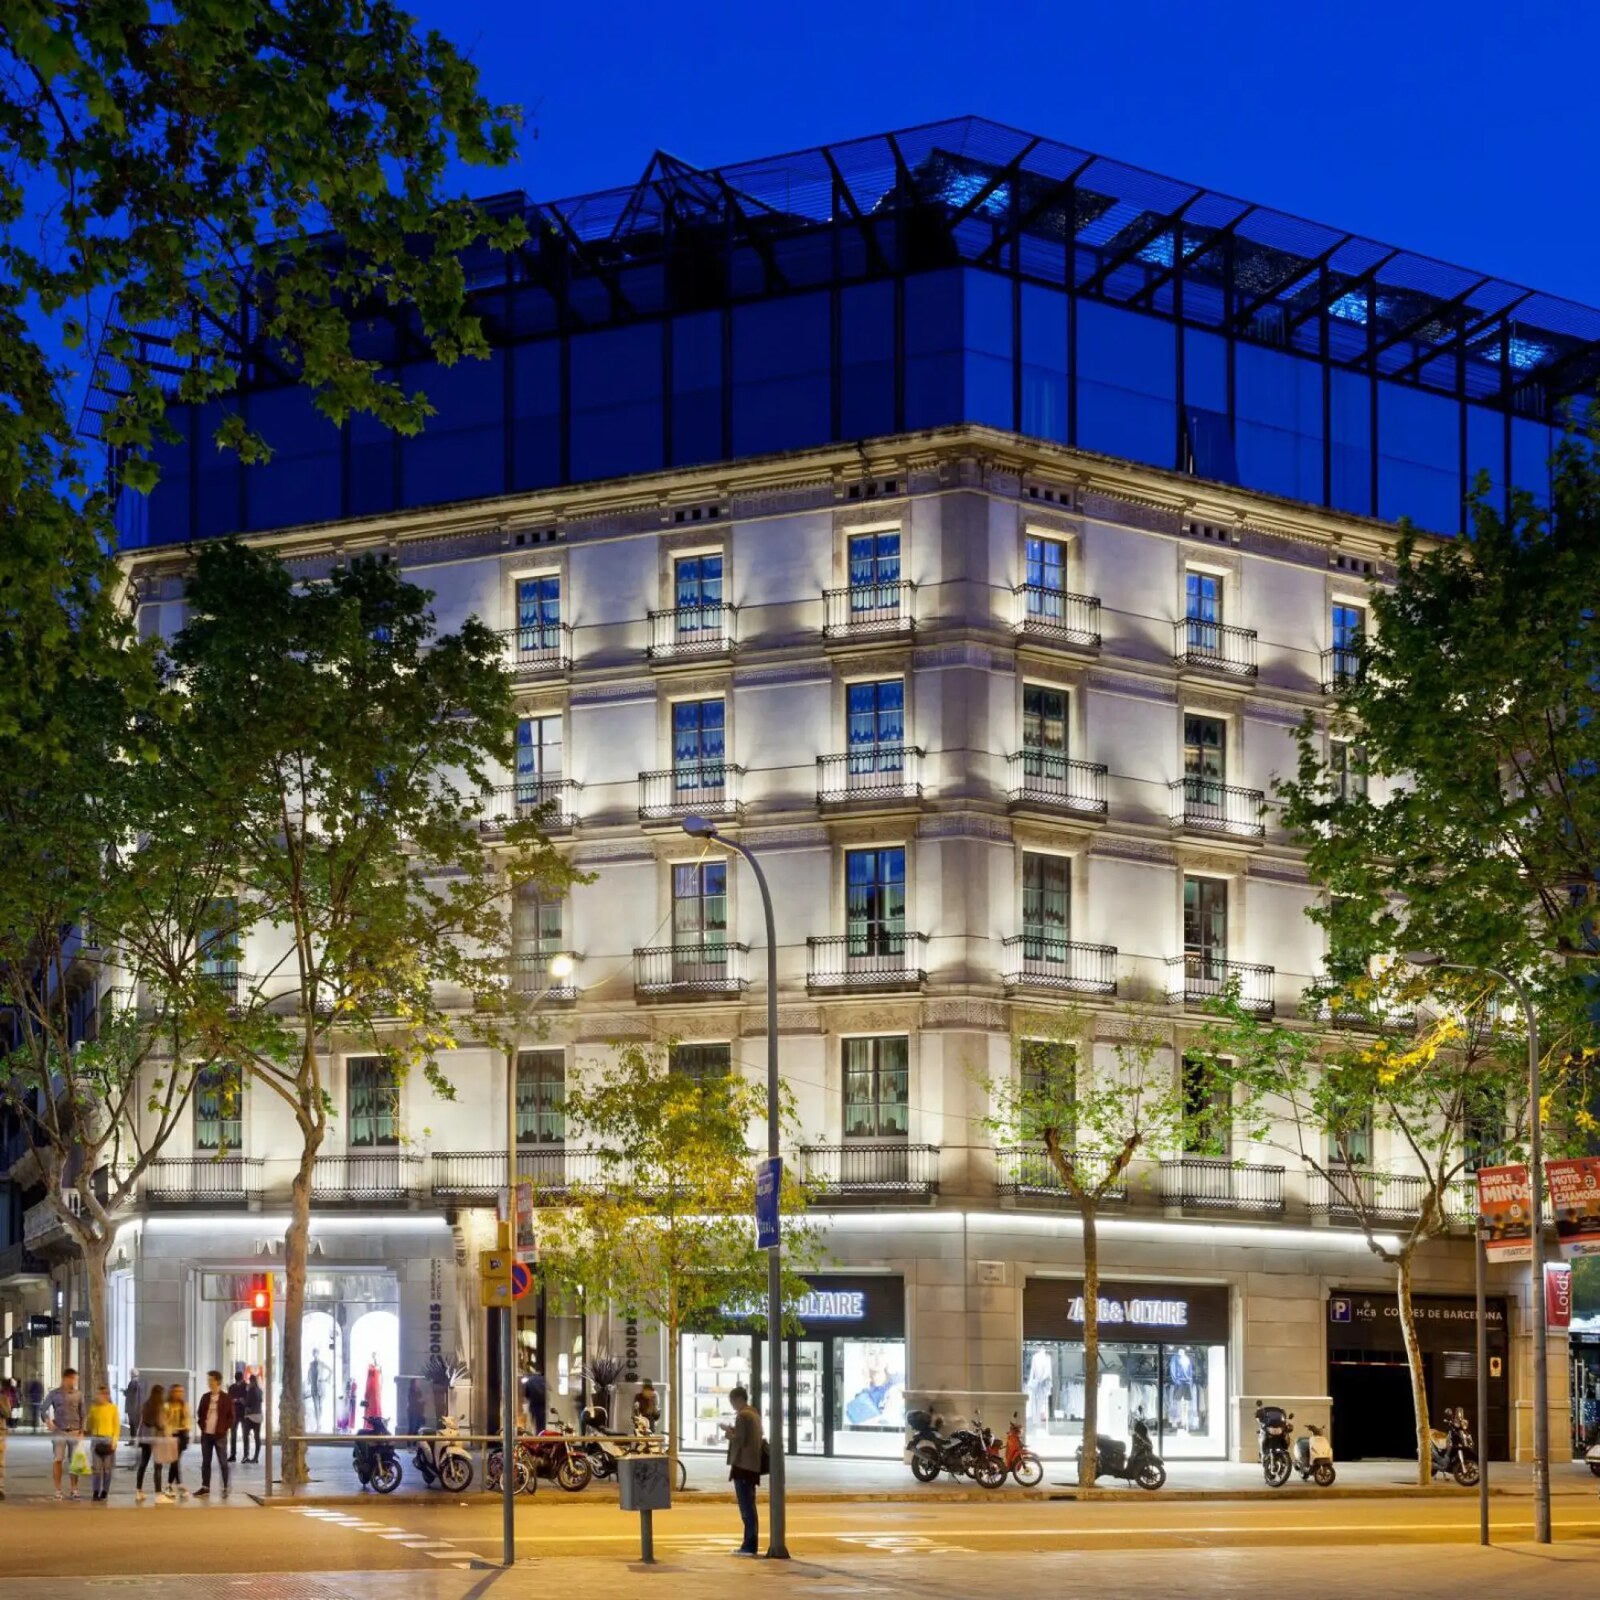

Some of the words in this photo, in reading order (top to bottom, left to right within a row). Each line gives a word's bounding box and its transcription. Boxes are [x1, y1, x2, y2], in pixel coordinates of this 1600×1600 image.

[1551, 1174, 1581, 1185] MOTIS
[1335, 1301, 1346, 1319] P
[1356, 1308, 1377, 1317] HCB
[1428, 1309, 1441, 1319] DE
